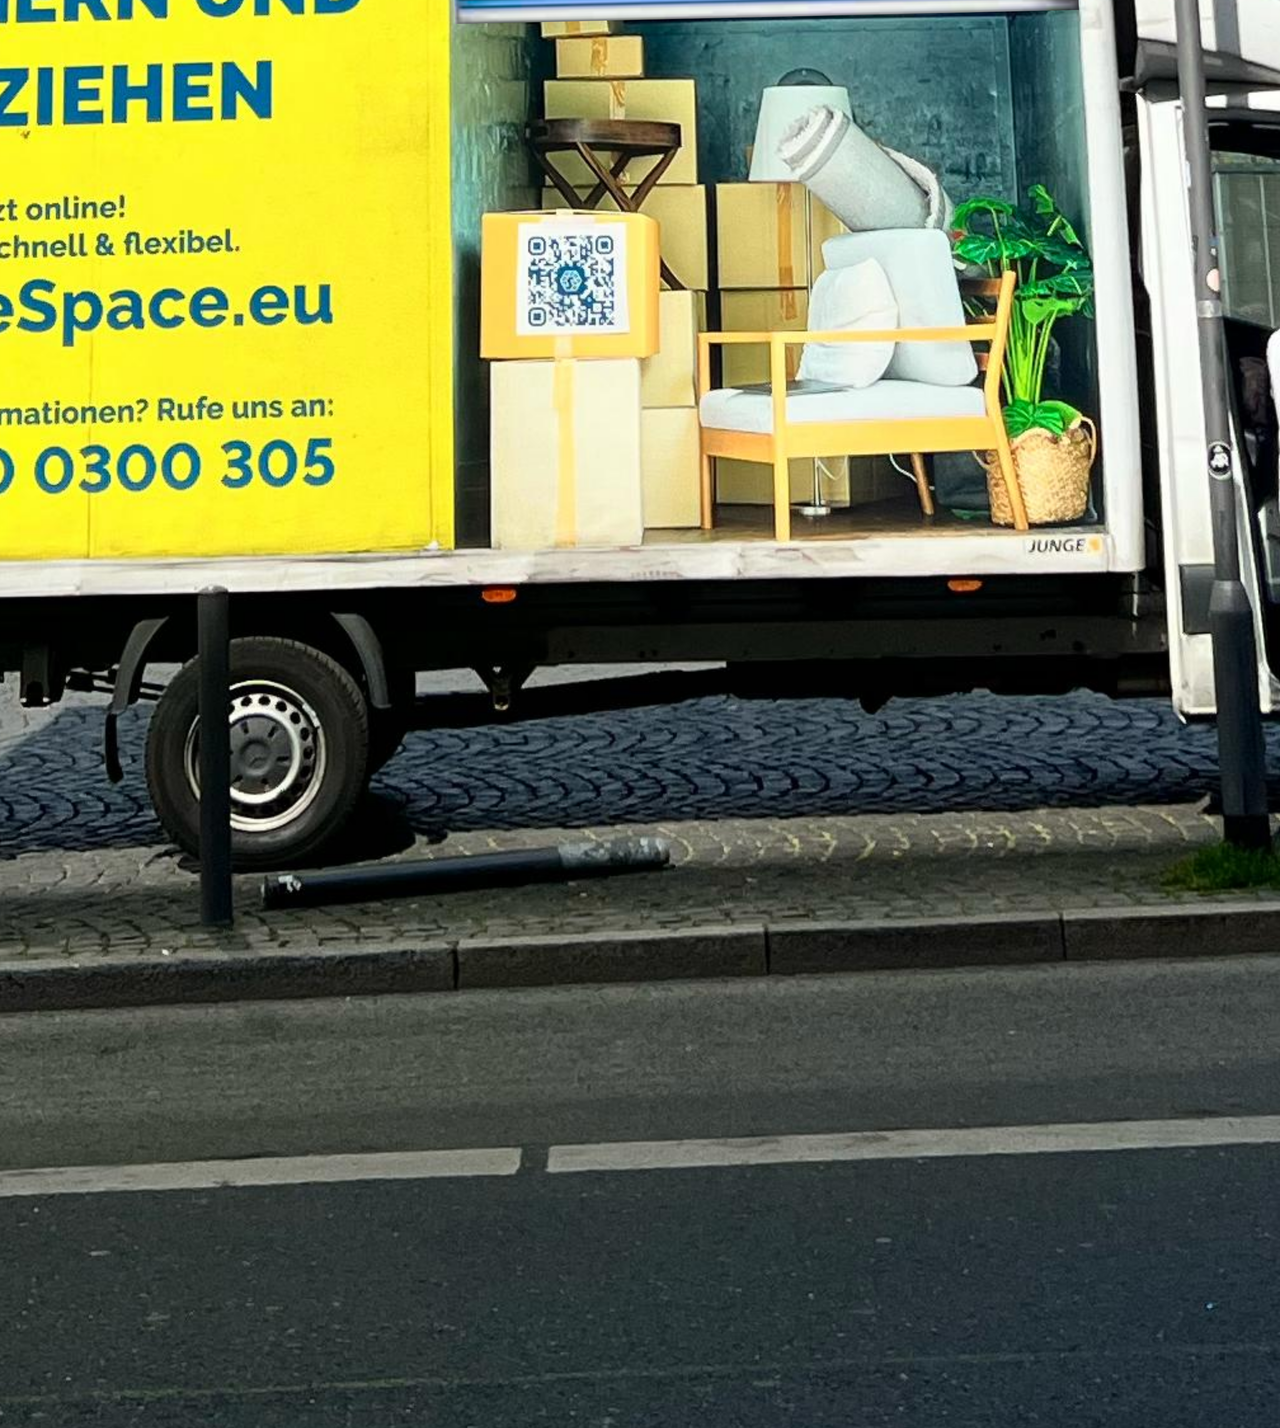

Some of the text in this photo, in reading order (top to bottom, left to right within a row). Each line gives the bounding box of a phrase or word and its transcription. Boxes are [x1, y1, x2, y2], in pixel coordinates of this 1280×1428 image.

[25, 194, 127, 221] online!
[94, 232, 116, 257] &
[123, 228, 241, 256] flexibel.
[157, 395, 225, 422] Rufe
[232, 399, 284, 420] uns
[290, 398, 335, 418] an:
[33, 441, 202, 495] 0300
[220, 437, 336, 489] 305
[1028, 538, 1085, 553] JUNGE
